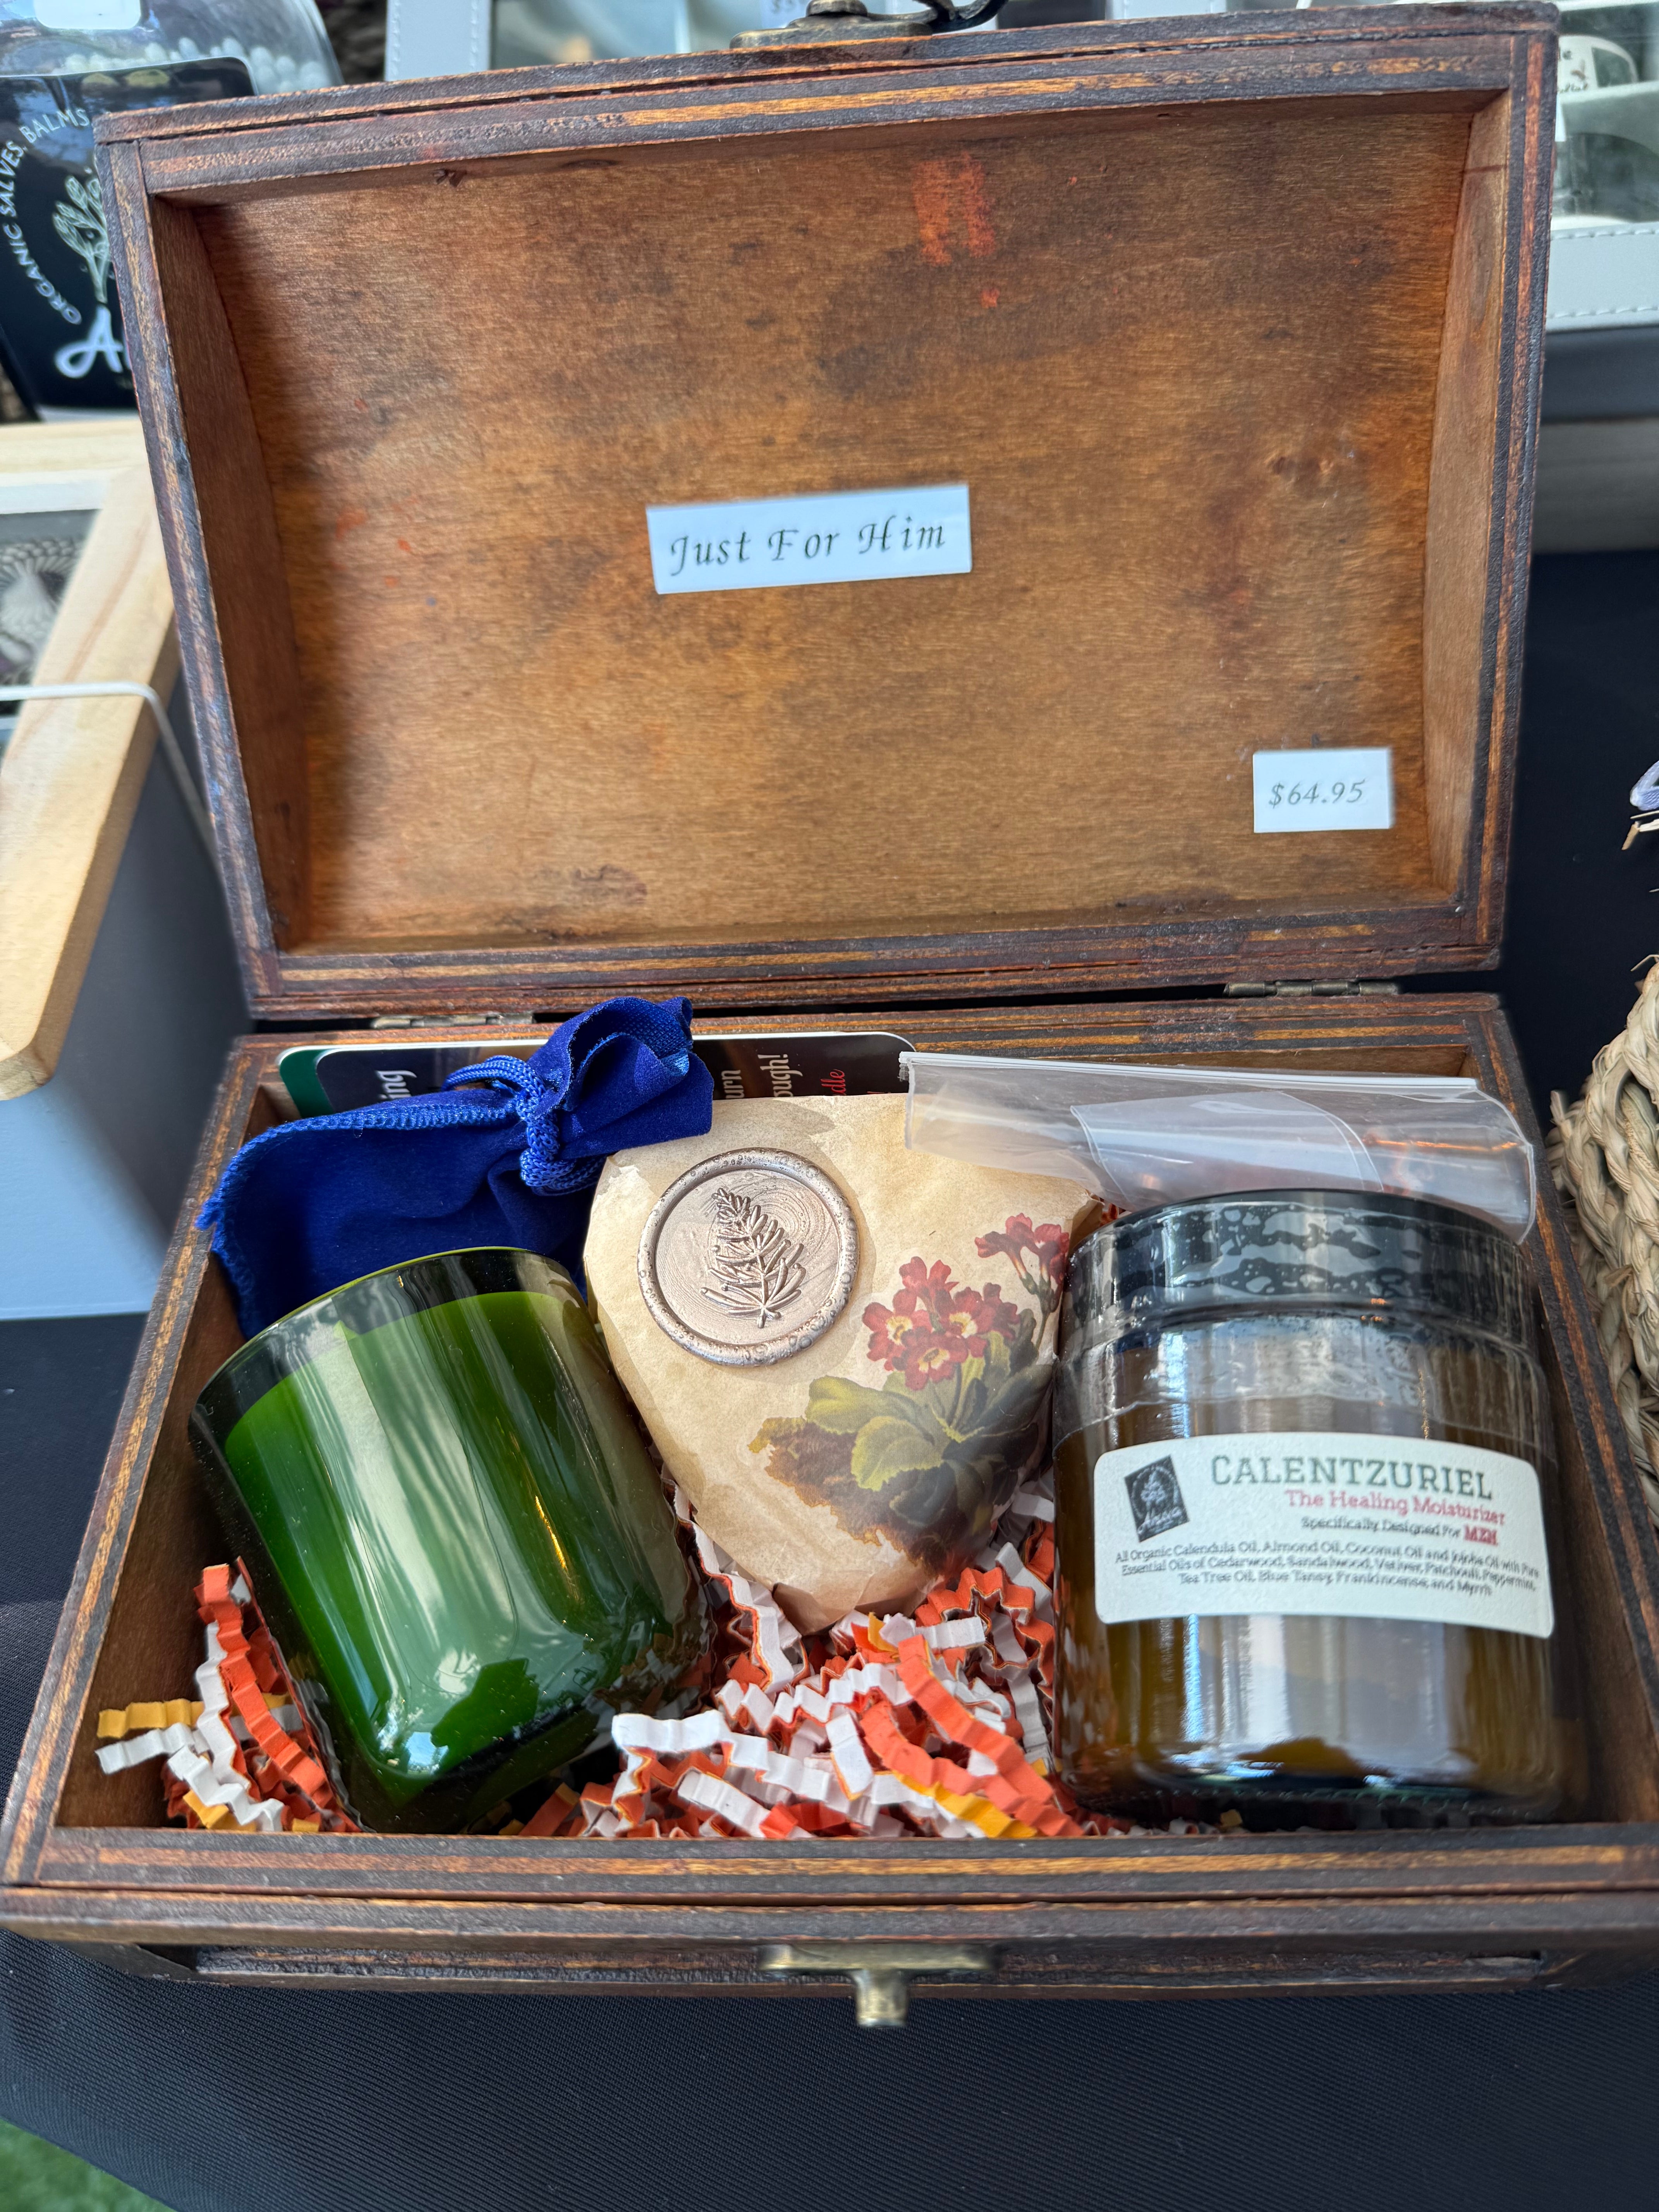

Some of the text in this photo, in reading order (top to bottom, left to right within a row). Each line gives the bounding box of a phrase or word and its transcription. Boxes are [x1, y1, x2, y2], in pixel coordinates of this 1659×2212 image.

[19, 108, 90, 144] BALMS
[3, 223, 82, 325] ORGANIC
[670, 515, 946, 577] Just For Him
[1268, 777, 1366, 809] $64.95
[820, 1069, 847, 1096] dle
[1211, 1455, 1492, 1500] CALENTZURIEL
[1285, 1489, 1505, 1526] The Healing Moisturizer
[1301, 1516, 1379, 1532] Specifically
[1381, 1518, 1441, 1537] Designed
[1115, 1551, 1129, 1563] All
[1130, 1546, 1172, 1561] Organic
[1174, 1542, 1236, 1556] Calendula
[1263, 1540, 1317, 1553] Almond
[1345, 1541, 1401, 1557] Coconut
[1404, 1545, 1422, 1558] Oil
[1426, 1548, 1449, 1560] and
[1121, 1559, 1166, 1576] Essential
[1193, 1556, 1205, 1568] of
[1178, 1572, 1200, 1585] Tea
[1201, 1571, 1231, 1583] Tree
[1259, 1569, 1289, 1583] Blue
[1432, 1578, 1454, 1590] and
